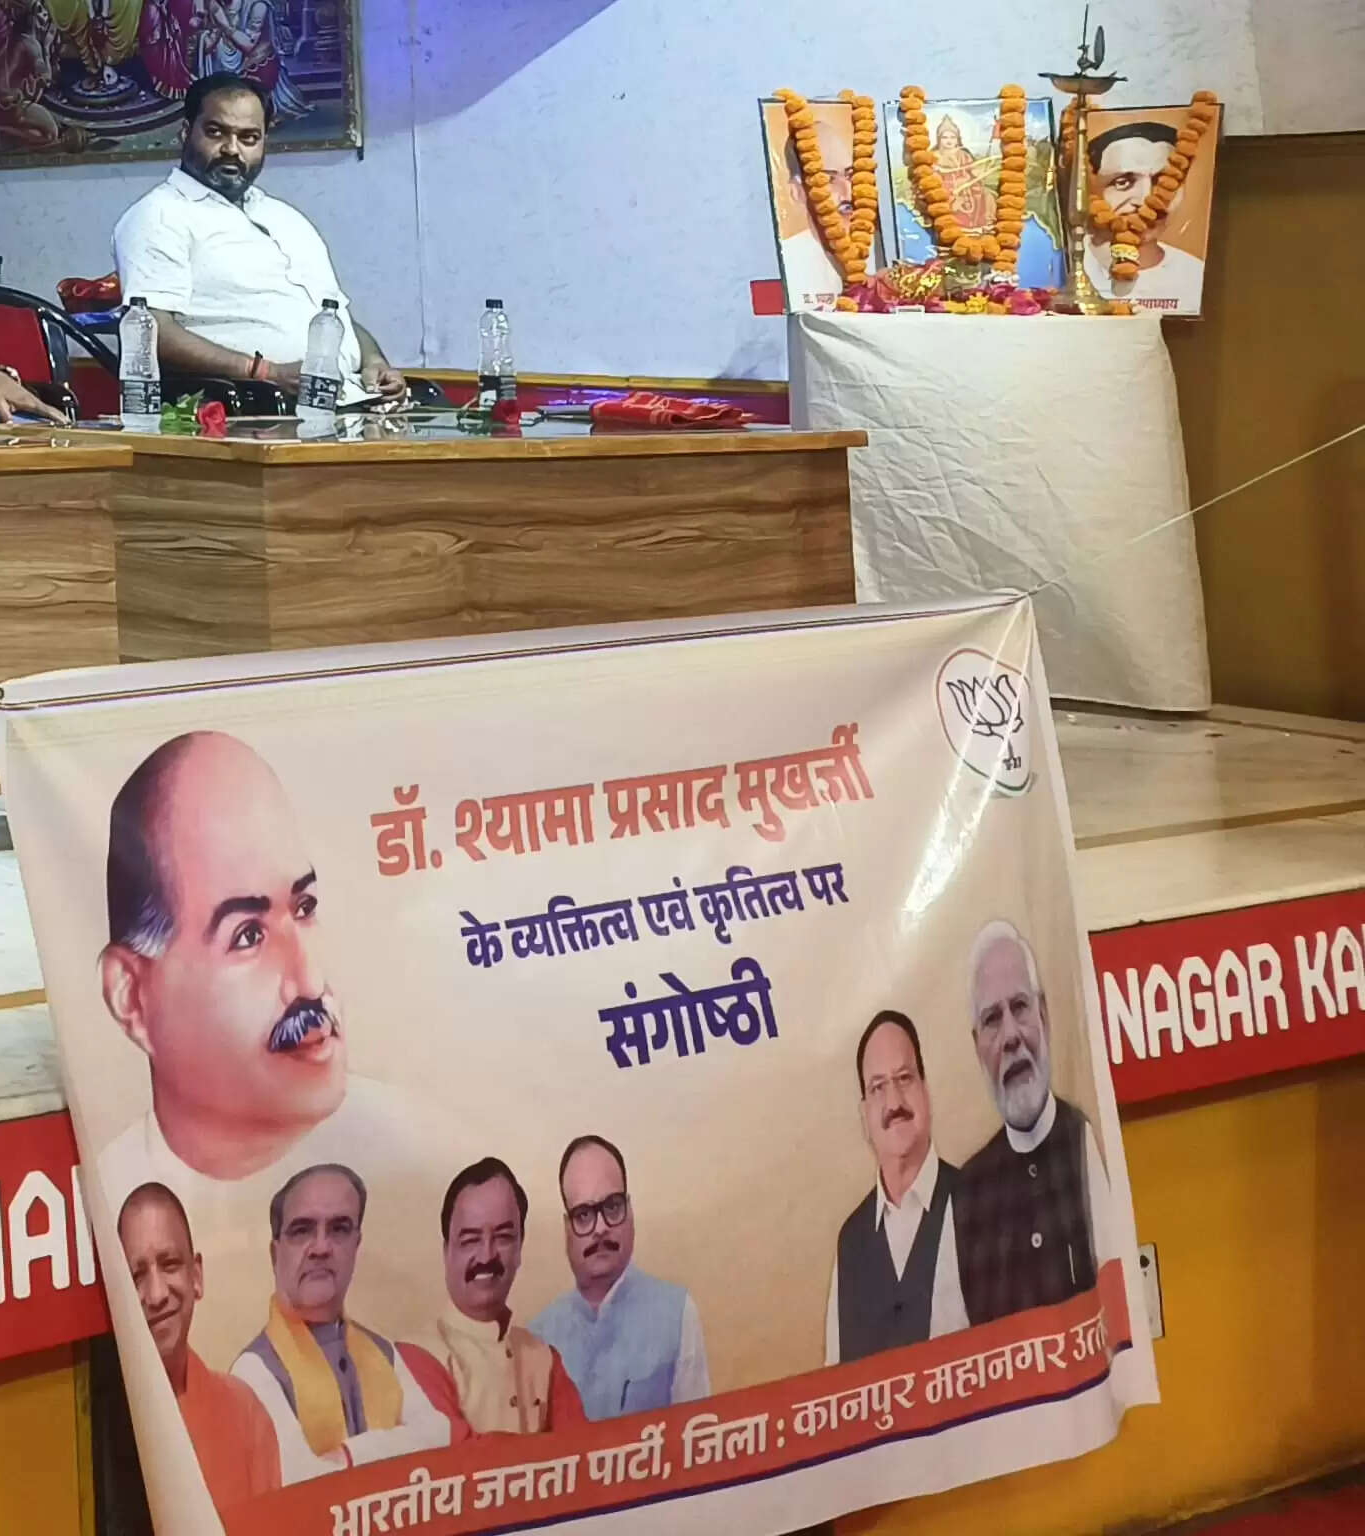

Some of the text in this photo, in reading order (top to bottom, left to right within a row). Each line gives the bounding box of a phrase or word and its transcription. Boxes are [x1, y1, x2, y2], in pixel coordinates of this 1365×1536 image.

[371, 723, 875, 876] डॉ. श्यामा प्रसाद मुखर्जी
[459, 863, 849, 968] के व्यक्तित्व एवं कृतित्व पर
[598, 957, 779, 1068] संगोष्ठी
[1103, 923, 1365, 1065] NAGAR KA
[330, 1467, 466, 1536] भारतीय
[473, 1455, 580, 1510] जनता
[587, 1422, 672, 1486] पार्टी,
[791, 1372, 917, 1431] कानपुर
[923, 1332, 1069, 1406] महानगर
